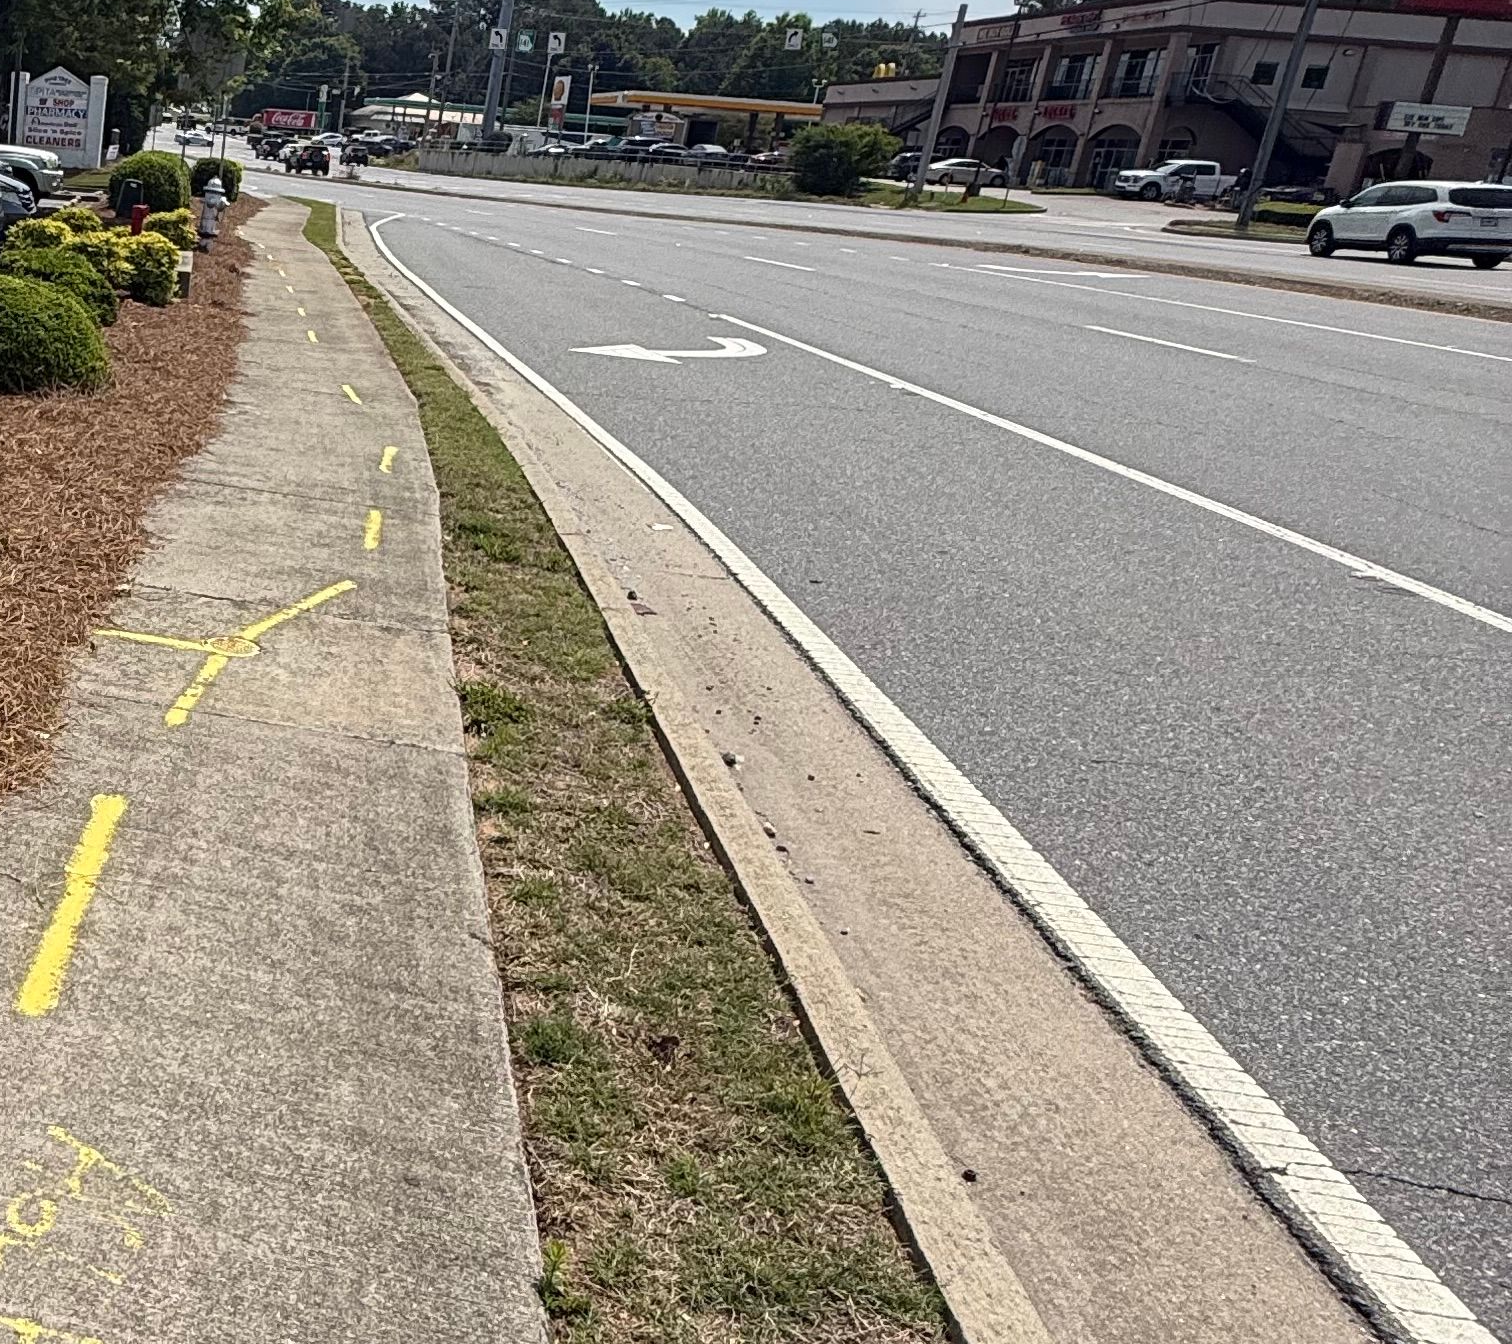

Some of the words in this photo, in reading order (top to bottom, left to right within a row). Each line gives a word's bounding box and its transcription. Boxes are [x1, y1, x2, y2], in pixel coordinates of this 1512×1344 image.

[53, 98, 74, 107] SHOP
[28, 106, 87, 118] PHARMACY
[26, 136, 81, 147] CLEANERS
